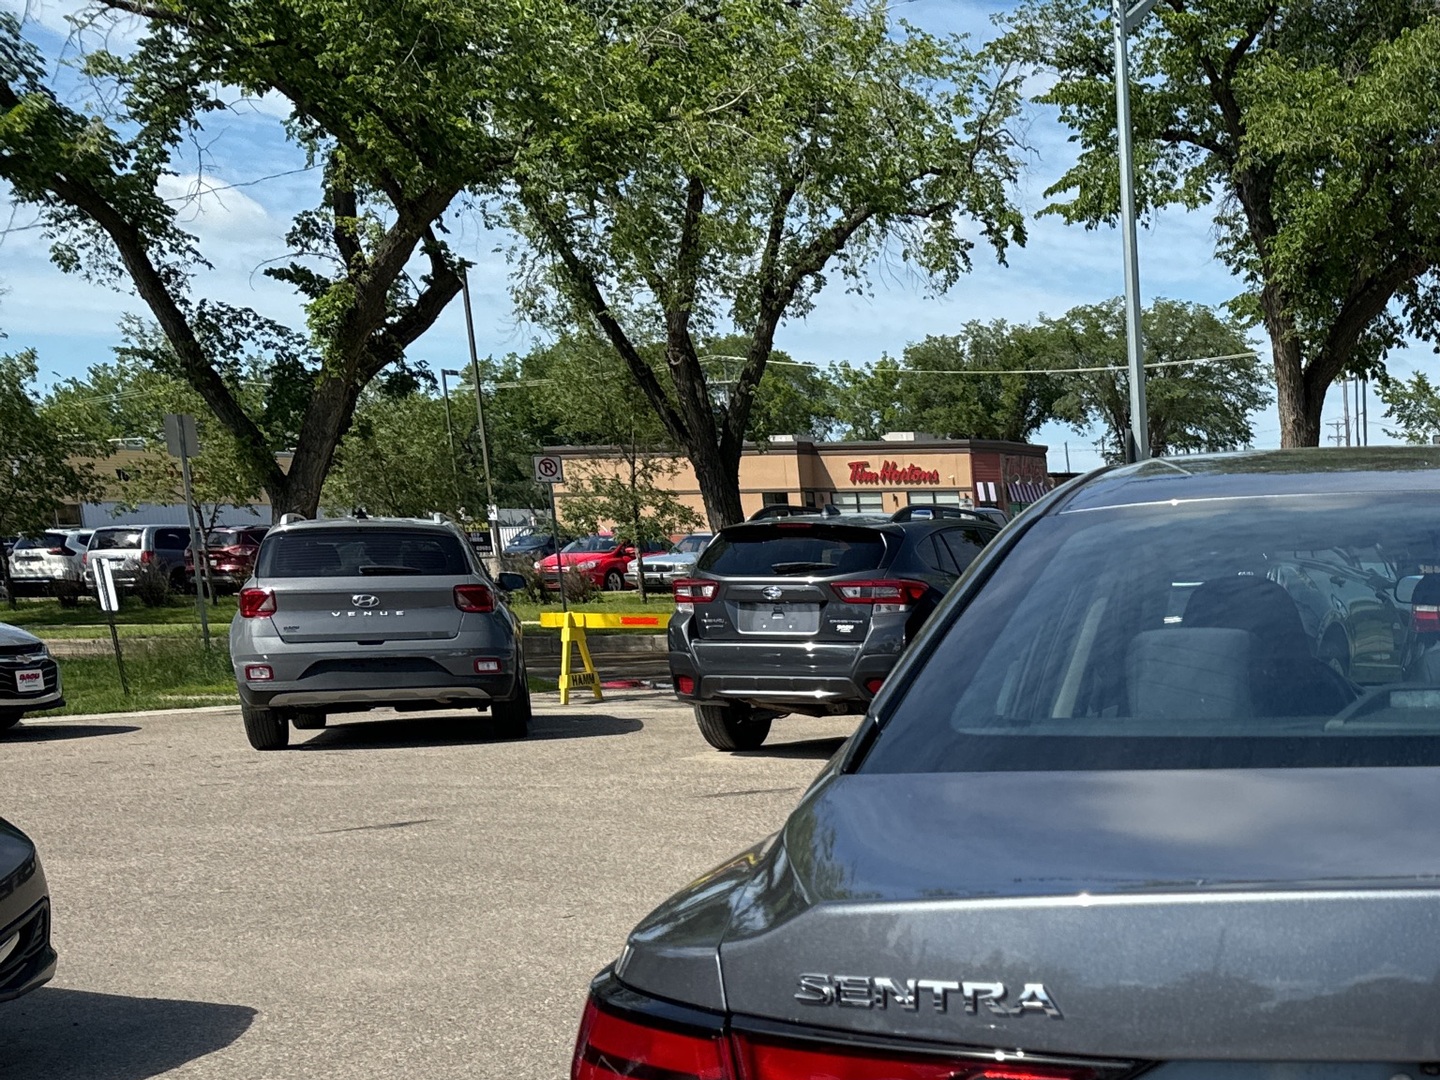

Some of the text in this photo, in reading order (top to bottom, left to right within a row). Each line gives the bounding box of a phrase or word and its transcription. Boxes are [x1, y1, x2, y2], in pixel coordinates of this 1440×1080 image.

[847, 460, 940, 485] Tim Hortons
[794, 973, 1064, 1019] SENTRA
